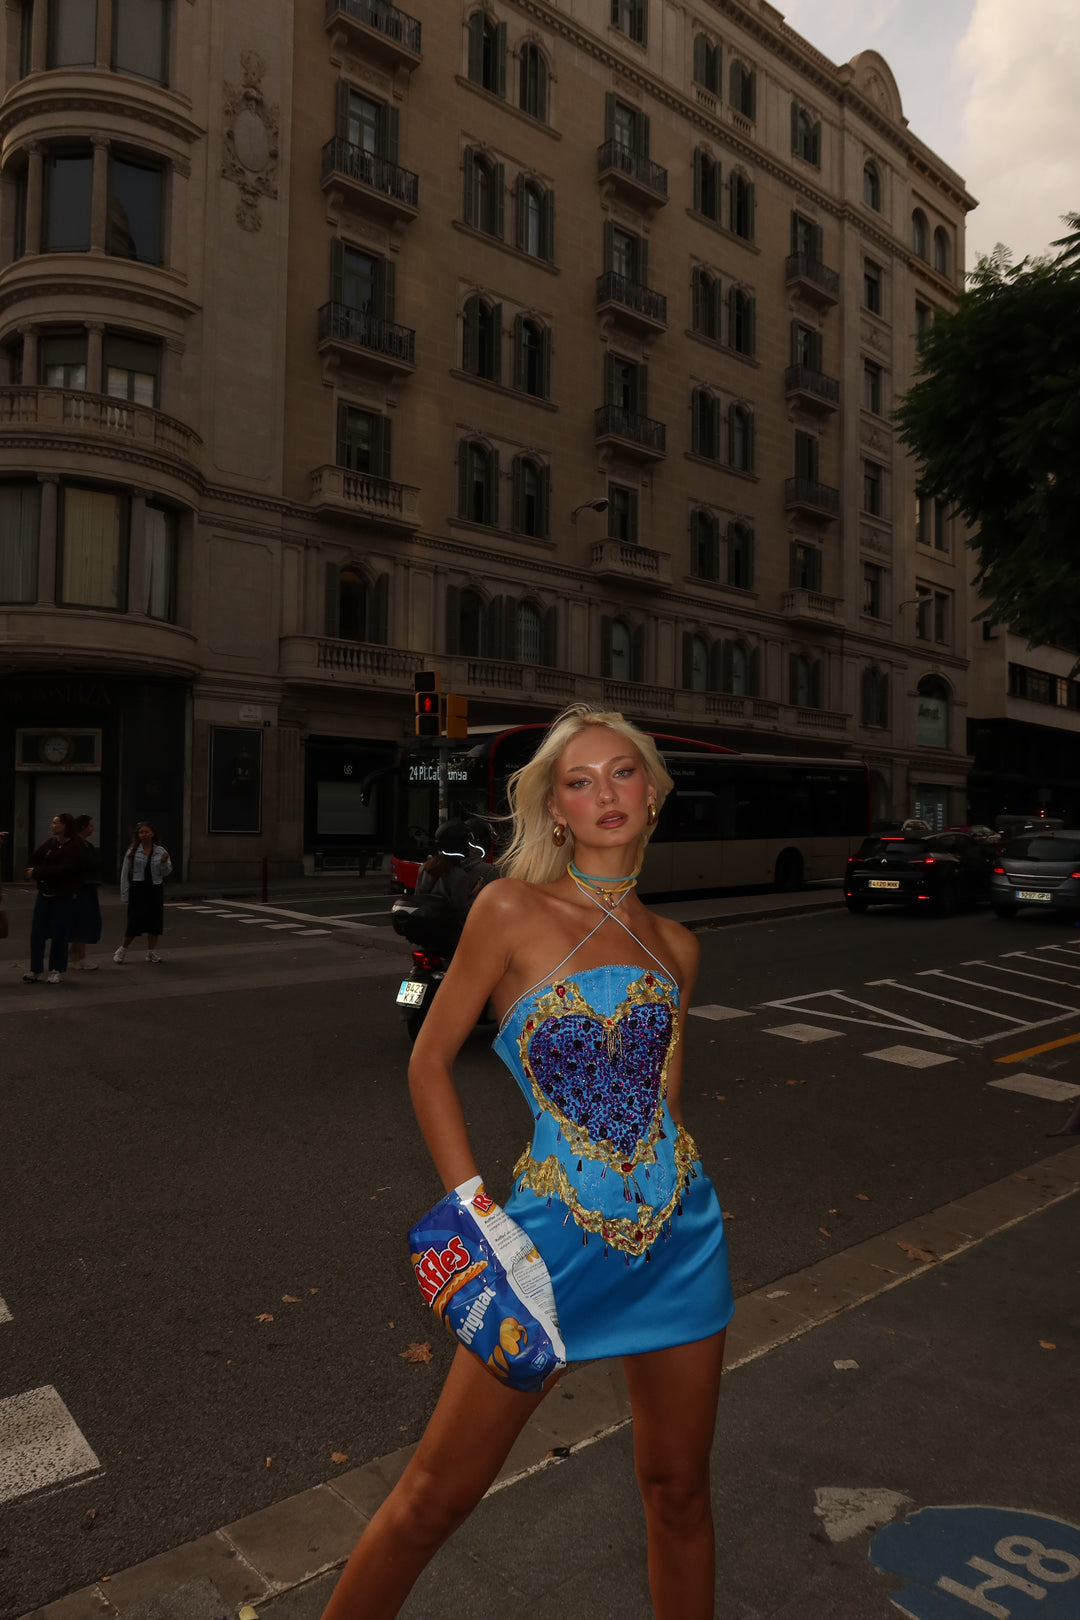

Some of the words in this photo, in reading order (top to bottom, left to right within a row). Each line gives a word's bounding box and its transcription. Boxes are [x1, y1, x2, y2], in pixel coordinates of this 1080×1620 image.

[409, 766, 418, 781] 24
[419, 766, 468, 781] Pl.Catunya
[414, 1234, 470, 1309] ffles
[456, 1285, 497, 1345] Original
[936, 1534, 1080, 1620] H8
